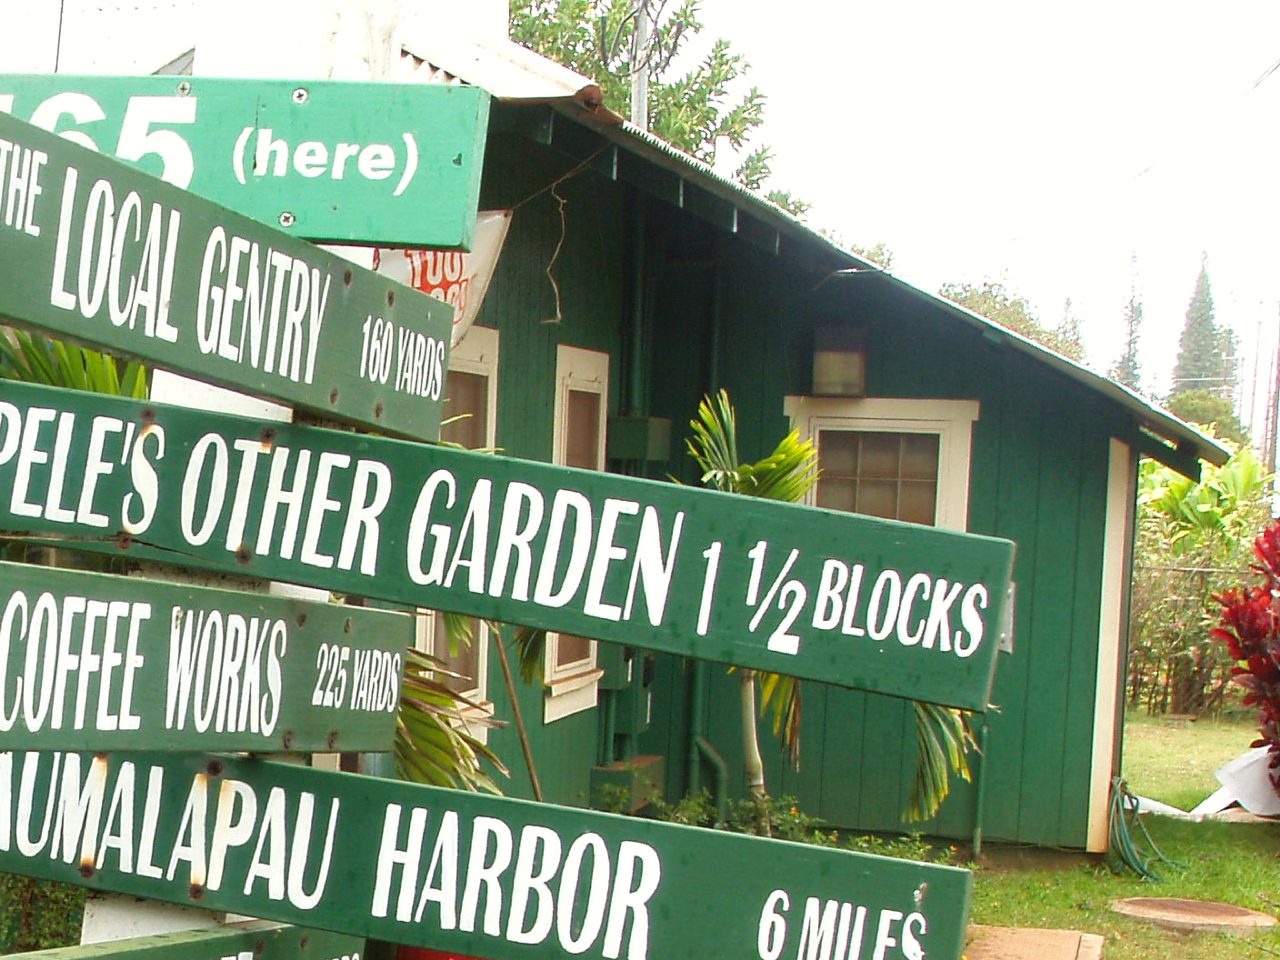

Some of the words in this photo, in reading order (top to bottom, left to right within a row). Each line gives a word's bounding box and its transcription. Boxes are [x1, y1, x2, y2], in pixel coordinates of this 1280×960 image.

[233, 127, 418, 196] (here)
[51, 166, 180, 343] LOCAL
[197, 226, 331, 384] GENTRY
[360, 315, 394, 385] 160
[395, 326, 445, 401] YARDS
[181, 433, 392, 576] OTHER
[406, 469, 684, 626] GARDEN
[696, 542, 721, 635] 1
[812, 559, 989, 657] BLOCKS
[166, 606, 287, 737] WORKS
[312, 643, 349, 708] 225
[349, 650, 402, 713] YARDS
